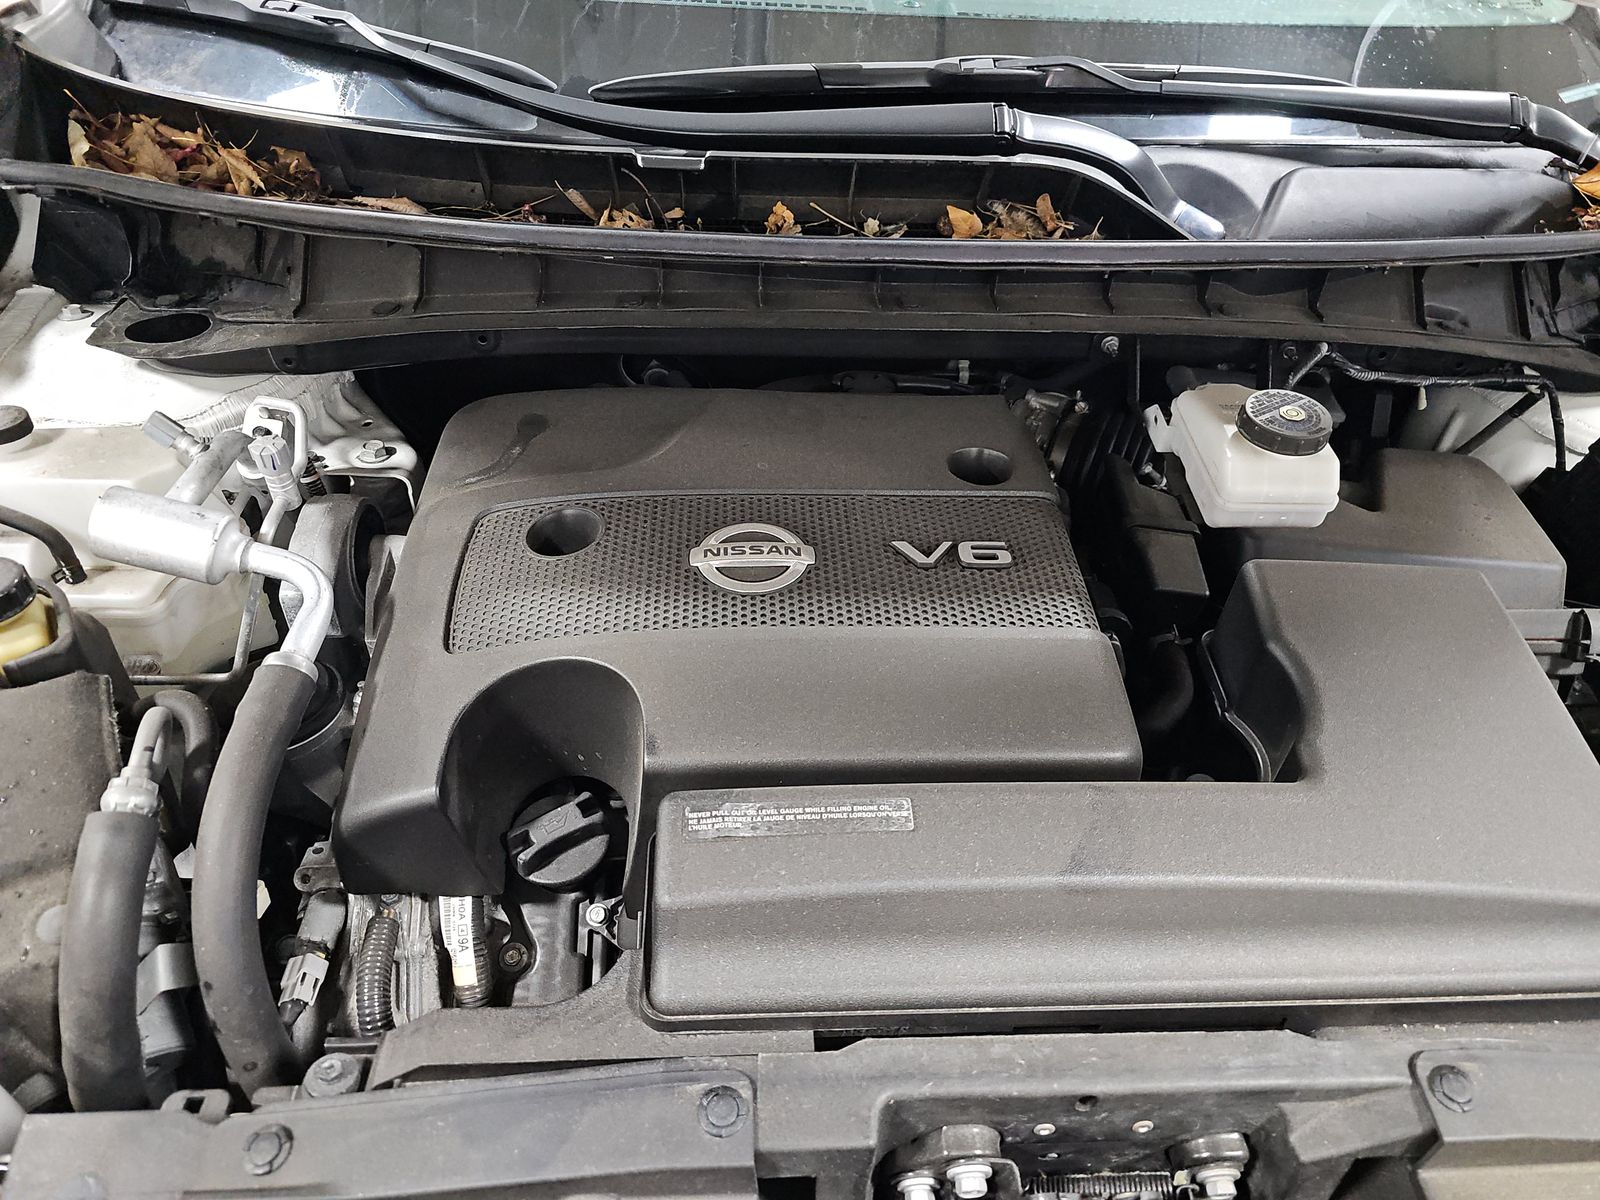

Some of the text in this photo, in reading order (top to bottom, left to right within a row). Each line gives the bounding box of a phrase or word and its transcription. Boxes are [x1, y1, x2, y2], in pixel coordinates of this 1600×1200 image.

[703, 544, 802, 559] NISSAN
[890, 540, 1013, 568] V6
[688, 811, 711, 819] NEVER
[796, 812, 821, 820] NIVEAU
